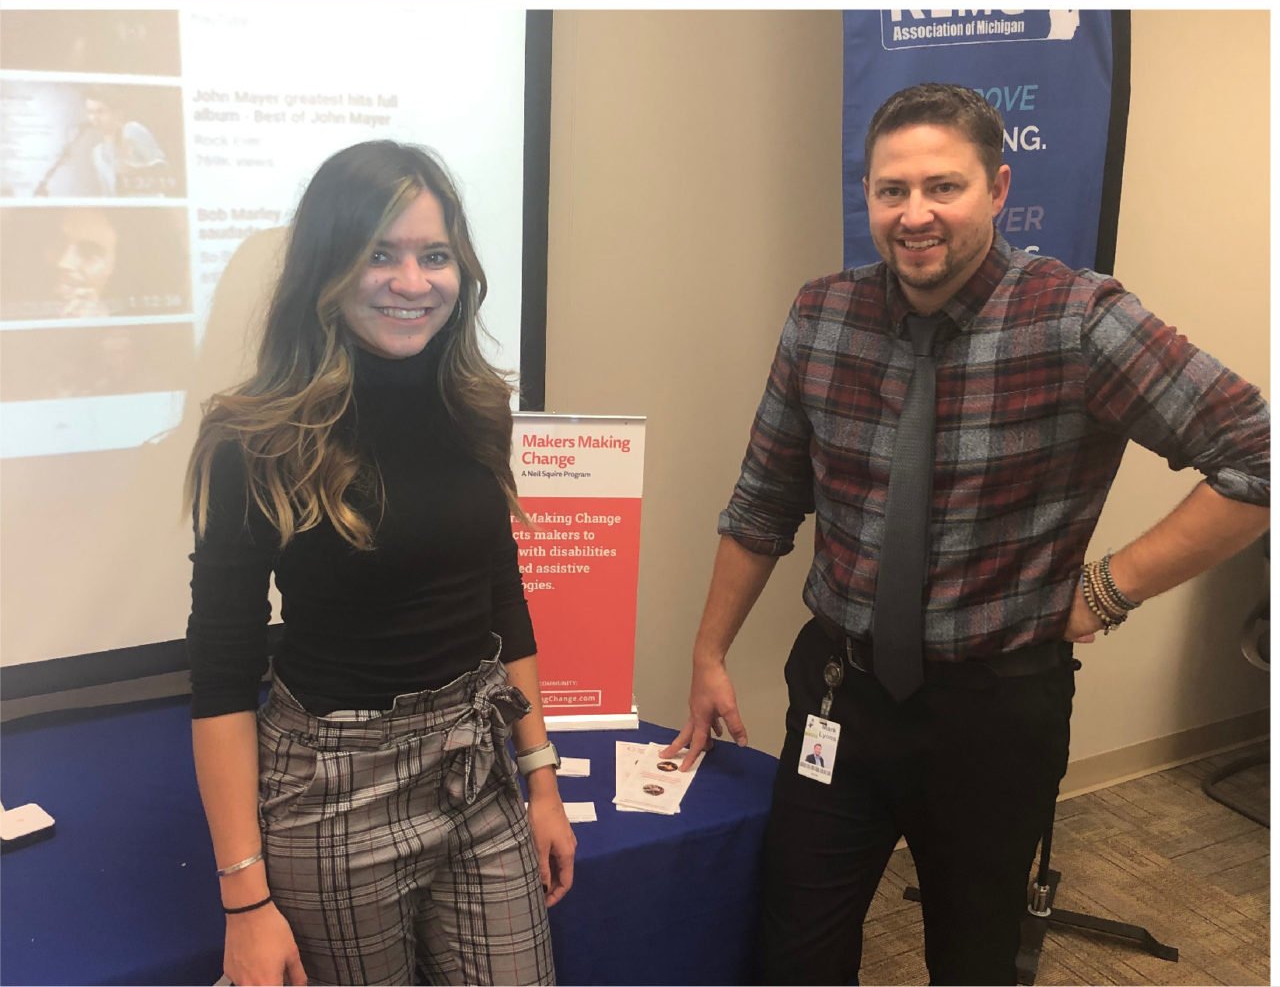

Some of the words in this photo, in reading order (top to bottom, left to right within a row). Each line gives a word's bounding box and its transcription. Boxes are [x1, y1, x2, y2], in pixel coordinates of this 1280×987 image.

[893, 23, 963, 40] Association
[966, 23, 974, 35] of
[977, 20, 1024, 37] Michigan
[193, 90, 229, 103] John
[234, 91, 279, 106] Mayer
[284, 94, 343, 108] greatest
[348, 94, 373, 107] hits
[377, 94, 399, 107] full
[194, 109, 240, 122] album
[254, 110, 286, 123] Best
[291, 110, 305, 123] of
[311, 111, 346, 125] John
[350, 112, 391, 128] Mayer
[198, 208, 227, 221] Bob
[231, 208, 281, 222] Marley
[522, 435, 575, 448] Makers
[578, 435, 631, 453] Making
[521, 452, 575, 468] Change
[542, 471, 562, 479] Squire
[564, 472, 591, 480] Program
[527, 513, 572, 526] Making
[575, 513, 621, 526] Change
[534, 530, 580, 540] makers
[584, 531, 595, 540] to
[519, 546, 546, 556] with
[549, 546, 617, 557] disabilities
[536, 563, 590, 574] assistive
